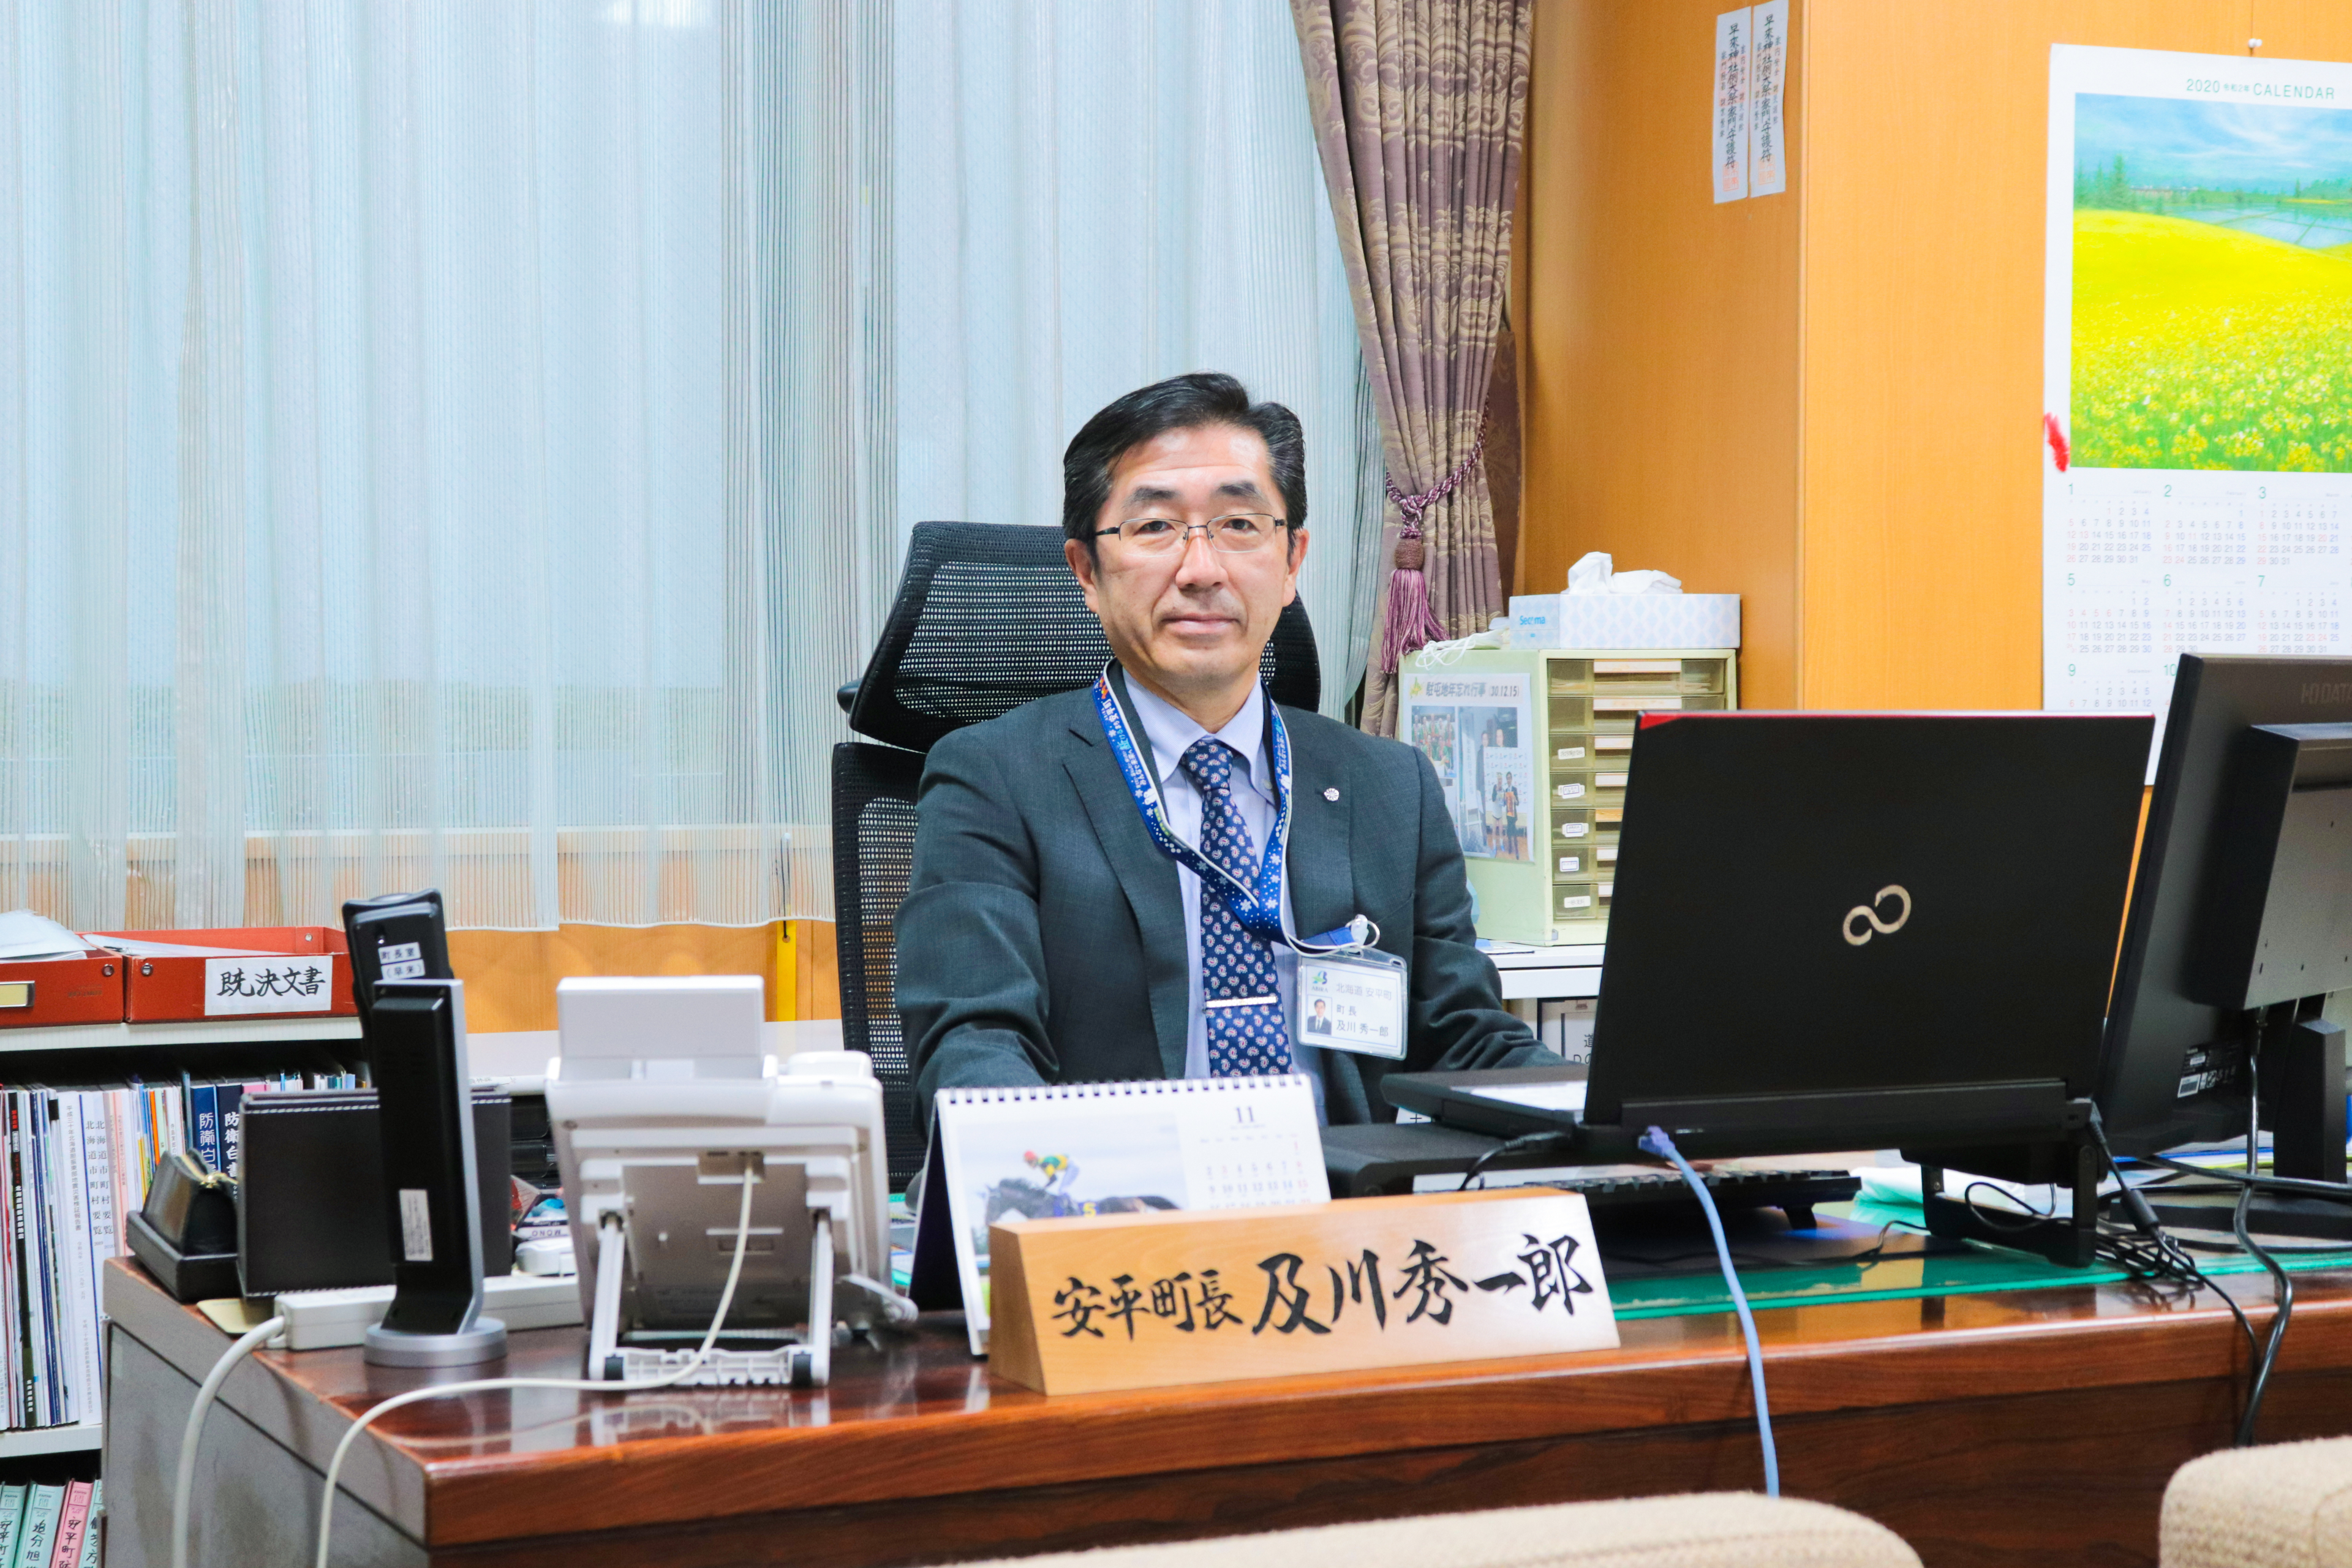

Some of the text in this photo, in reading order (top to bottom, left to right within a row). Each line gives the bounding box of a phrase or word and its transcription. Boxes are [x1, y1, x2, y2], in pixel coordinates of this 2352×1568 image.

[2187, 78, 2220, 93] 2020
[2253, 83, 2335, 99] CALENDAR
[2068, 482, 2073, 495] 1
[2164, 484, 2173, 498] 2
[2259, 486, 2267, 499] 3
[2269, 545, 2279, 554] 23
[2068, 573, 2076, 586] 5
[2164, 573, 2172, 587] 6
[2258, 575, 2266, 587] 7
[1520, 615, 1546, 625] Secma
[2068, 663, 2076, 677] 9
[381, 948, 415, 959] 町長室
[216, 966, 326, 997] 既決文書
[1336, 982, 1392, 1001] 北海道 安平町
[1336, 1022, 1389, 1038] 及川 秀一郎
[1236, 1106, 1254, 1123] 11
[224, 1112, 239, 1178] 防衛白書
[86, 1120, 103, 1235] 北海道市町村要覧
[96, 1120, 113, 1235] 北海道市町村要覧
[1052, 1232, 1594, 1341] 安平町長 及川秀一郎
[0, 1518, 13, 1568] 安平町
[24, 1519, 46, 1568] 追分旭
